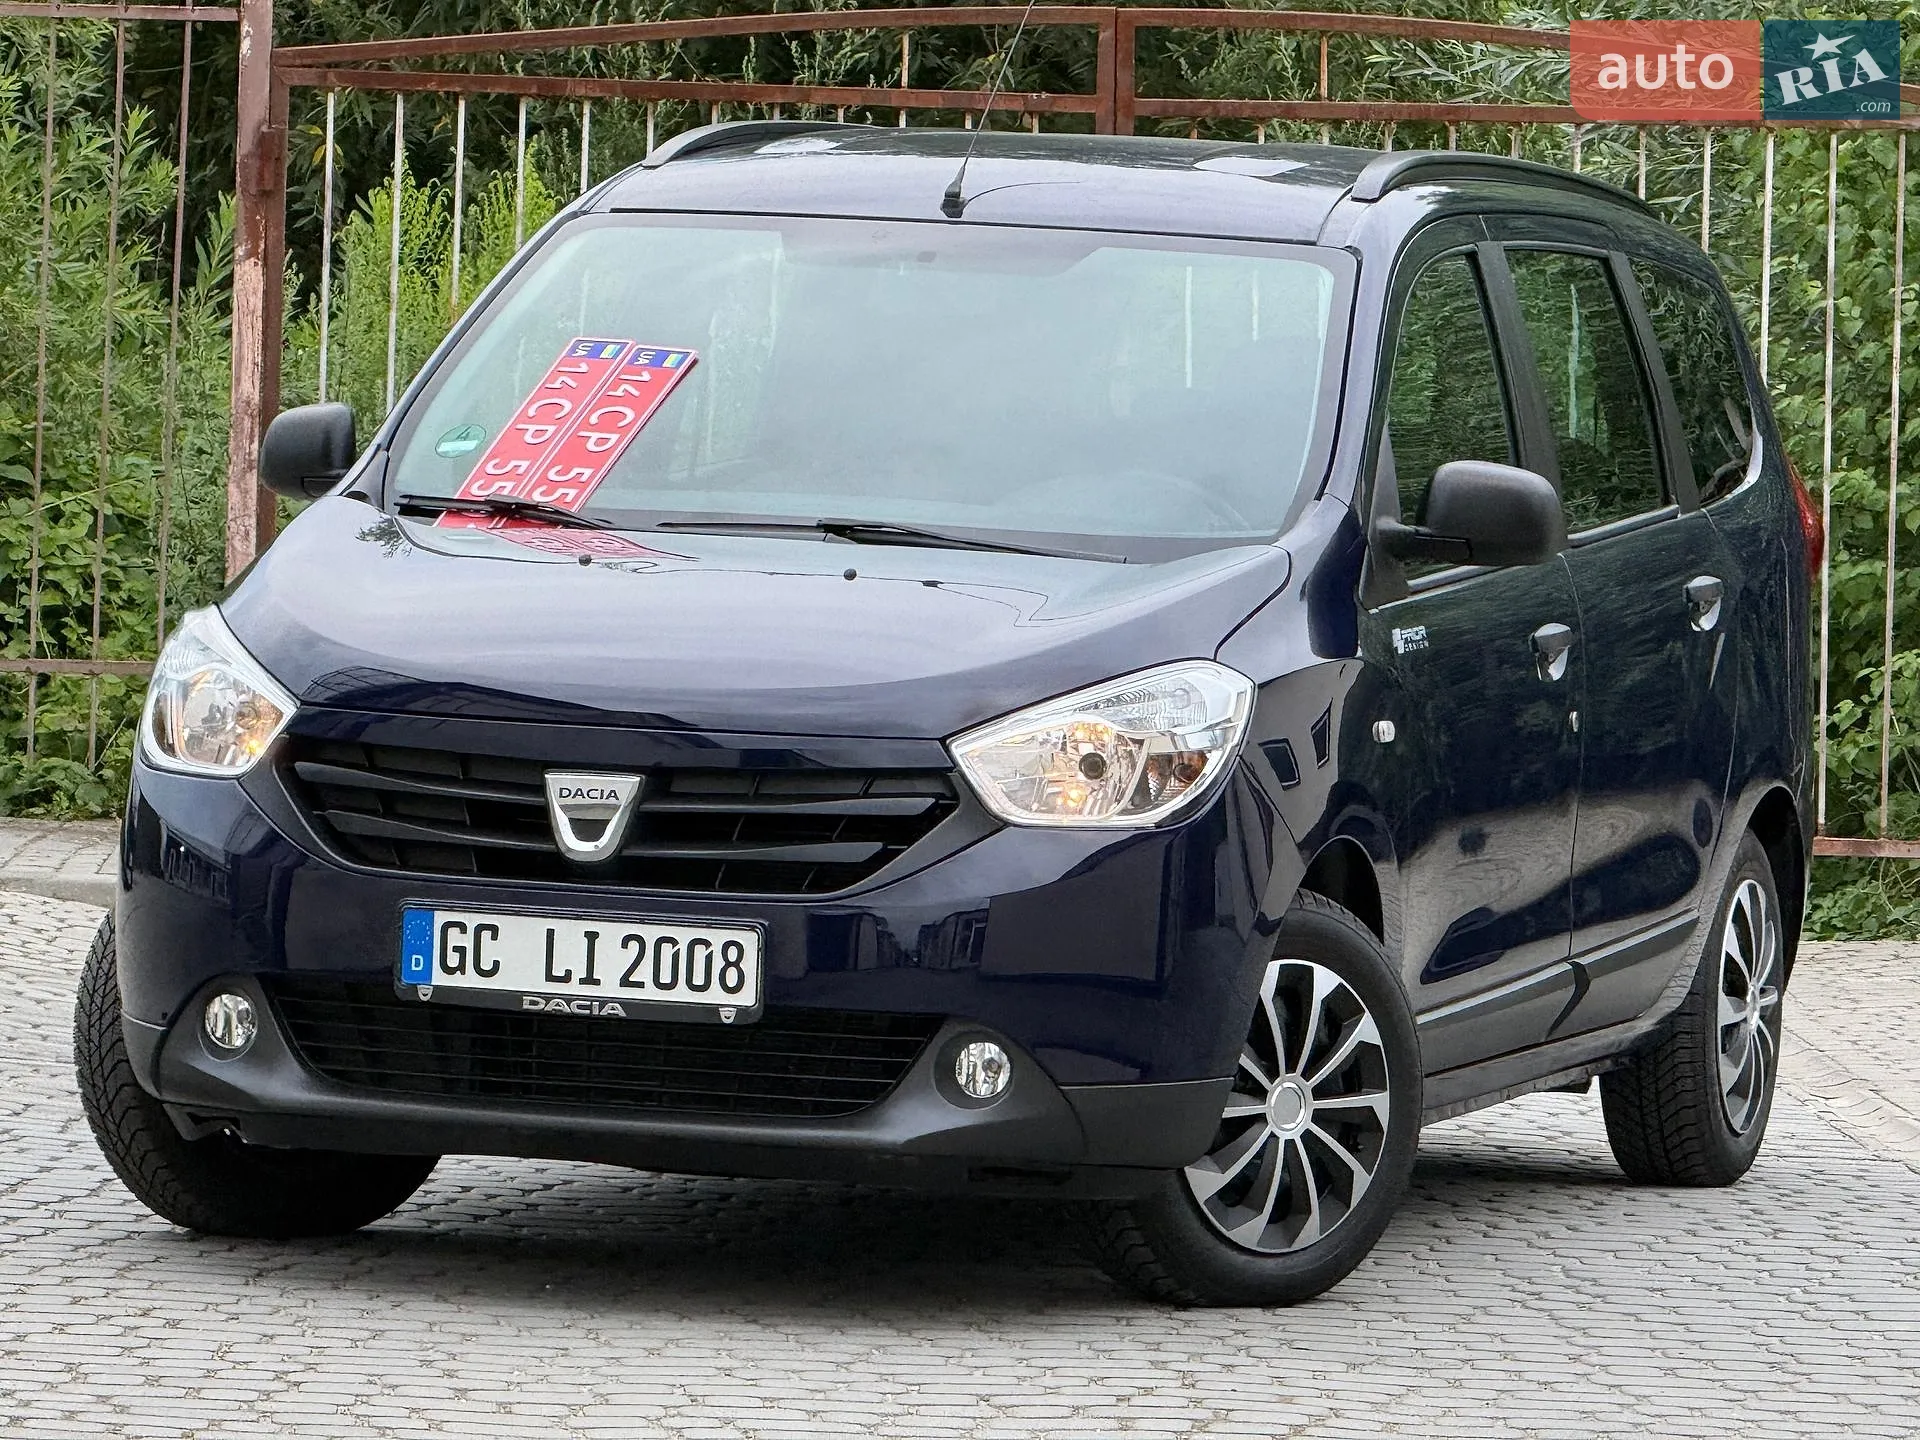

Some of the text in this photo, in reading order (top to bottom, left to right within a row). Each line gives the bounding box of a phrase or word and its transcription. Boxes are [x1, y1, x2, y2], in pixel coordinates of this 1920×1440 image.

[572, 342, 595, 357] UA
[633, 351, 657, 365] UA
[558, 787, 620, 801] DACIA
[411, 954, 424, 971] D
[438, 920, 746, 995] GC LI 2008
[522, 996, 628, 1018] DACIA
